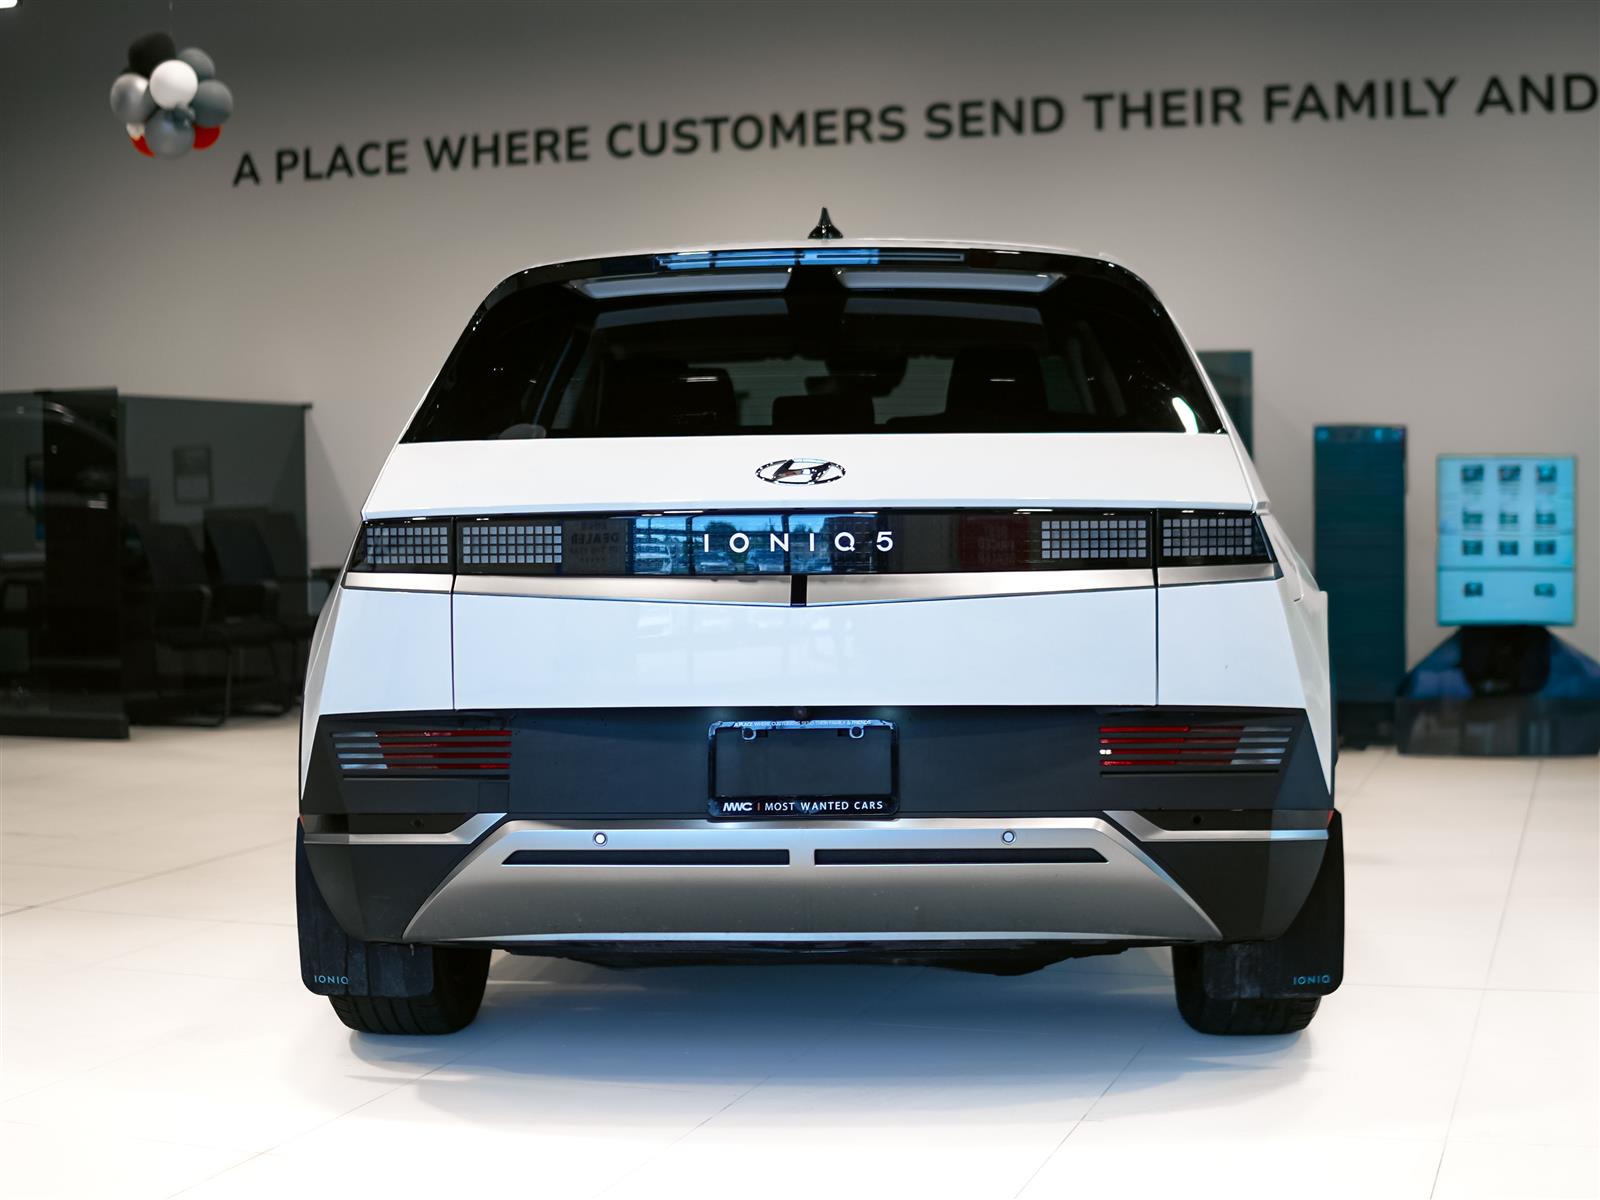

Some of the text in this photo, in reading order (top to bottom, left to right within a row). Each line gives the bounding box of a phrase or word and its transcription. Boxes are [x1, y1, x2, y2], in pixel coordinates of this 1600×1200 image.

[232, 72, 1600, 188] A PLACE WHERE CUSTOMERS SEND THEIR FAMILY AND
[704, 531, 893, 553] IONIQ 5
[764, 801, 796, 811] MOST
[800, 801, 850, 811] WANTED
[853, 800, 883, 810] CARS
[313, 975, 349, 985] IONIQ
[1293, 974, 1330, 985] IONIQ
